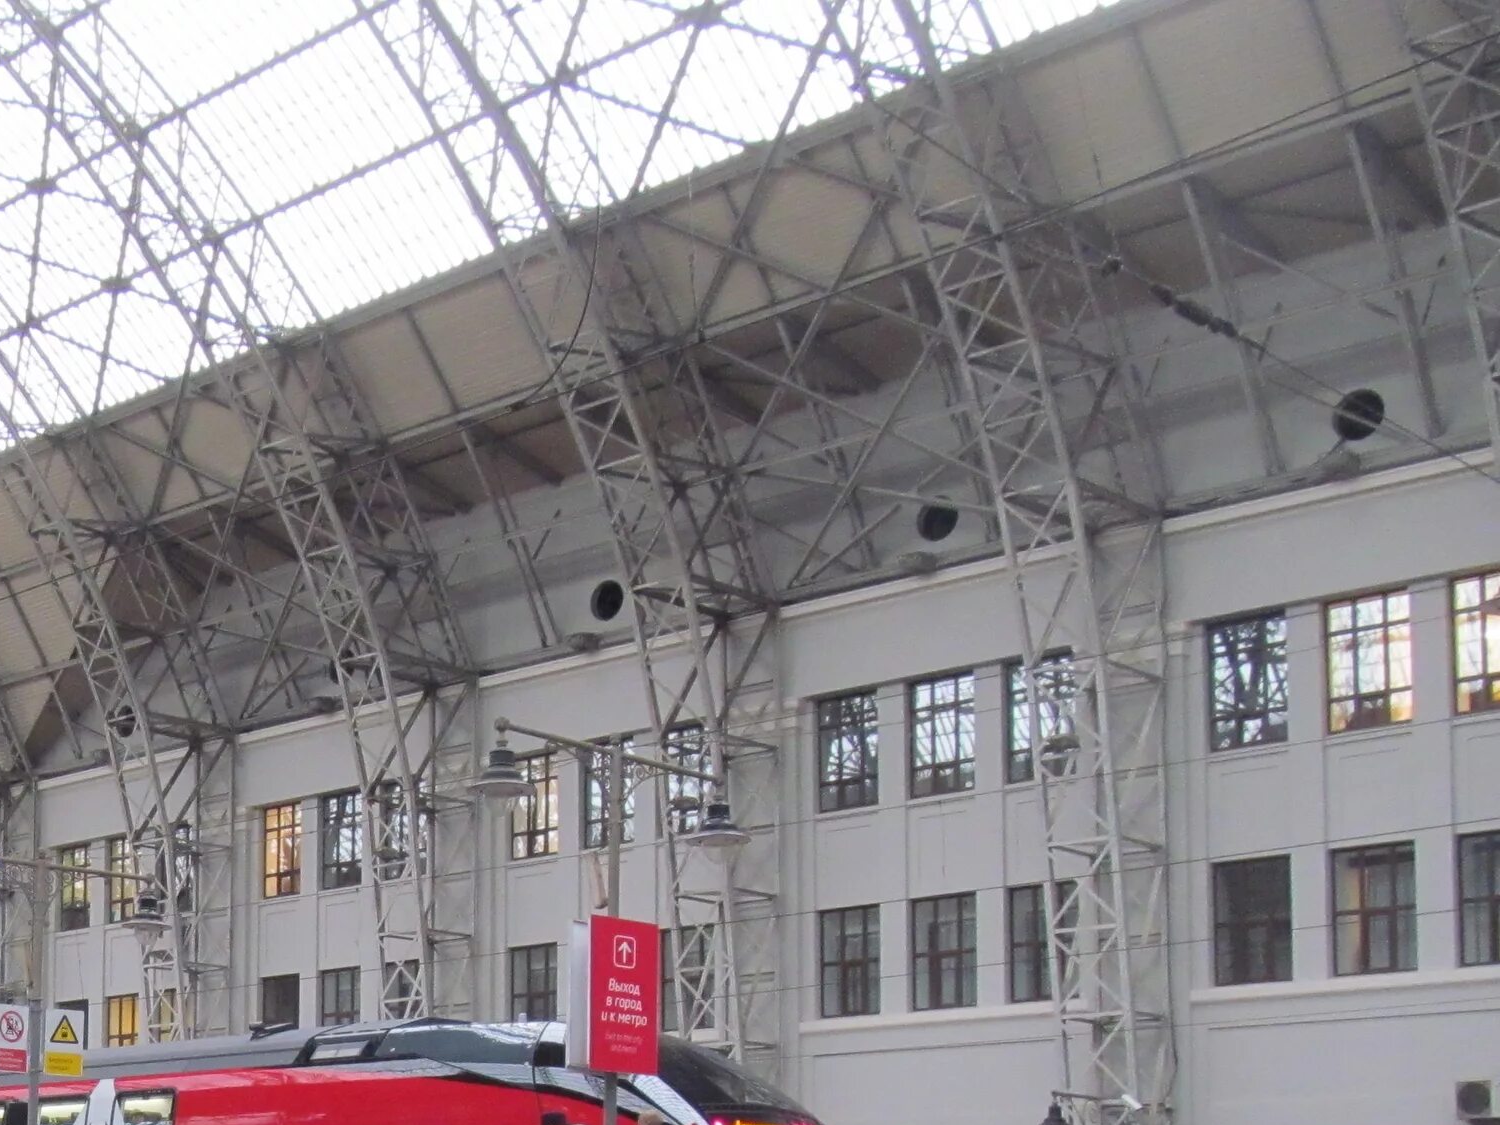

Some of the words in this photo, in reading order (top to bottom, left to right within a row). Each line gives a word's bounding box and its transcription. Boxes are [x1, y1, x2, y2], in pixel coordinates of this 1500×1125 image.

[608, 977, 640, 996] Выход
[606, 996, 612, 1006] в
[614, 997, 642, 1012] город
[601, 1011, 608, 1021] и
[610, 1012, 616, 1022] к
[617, 1013, 648, 1028] метро
